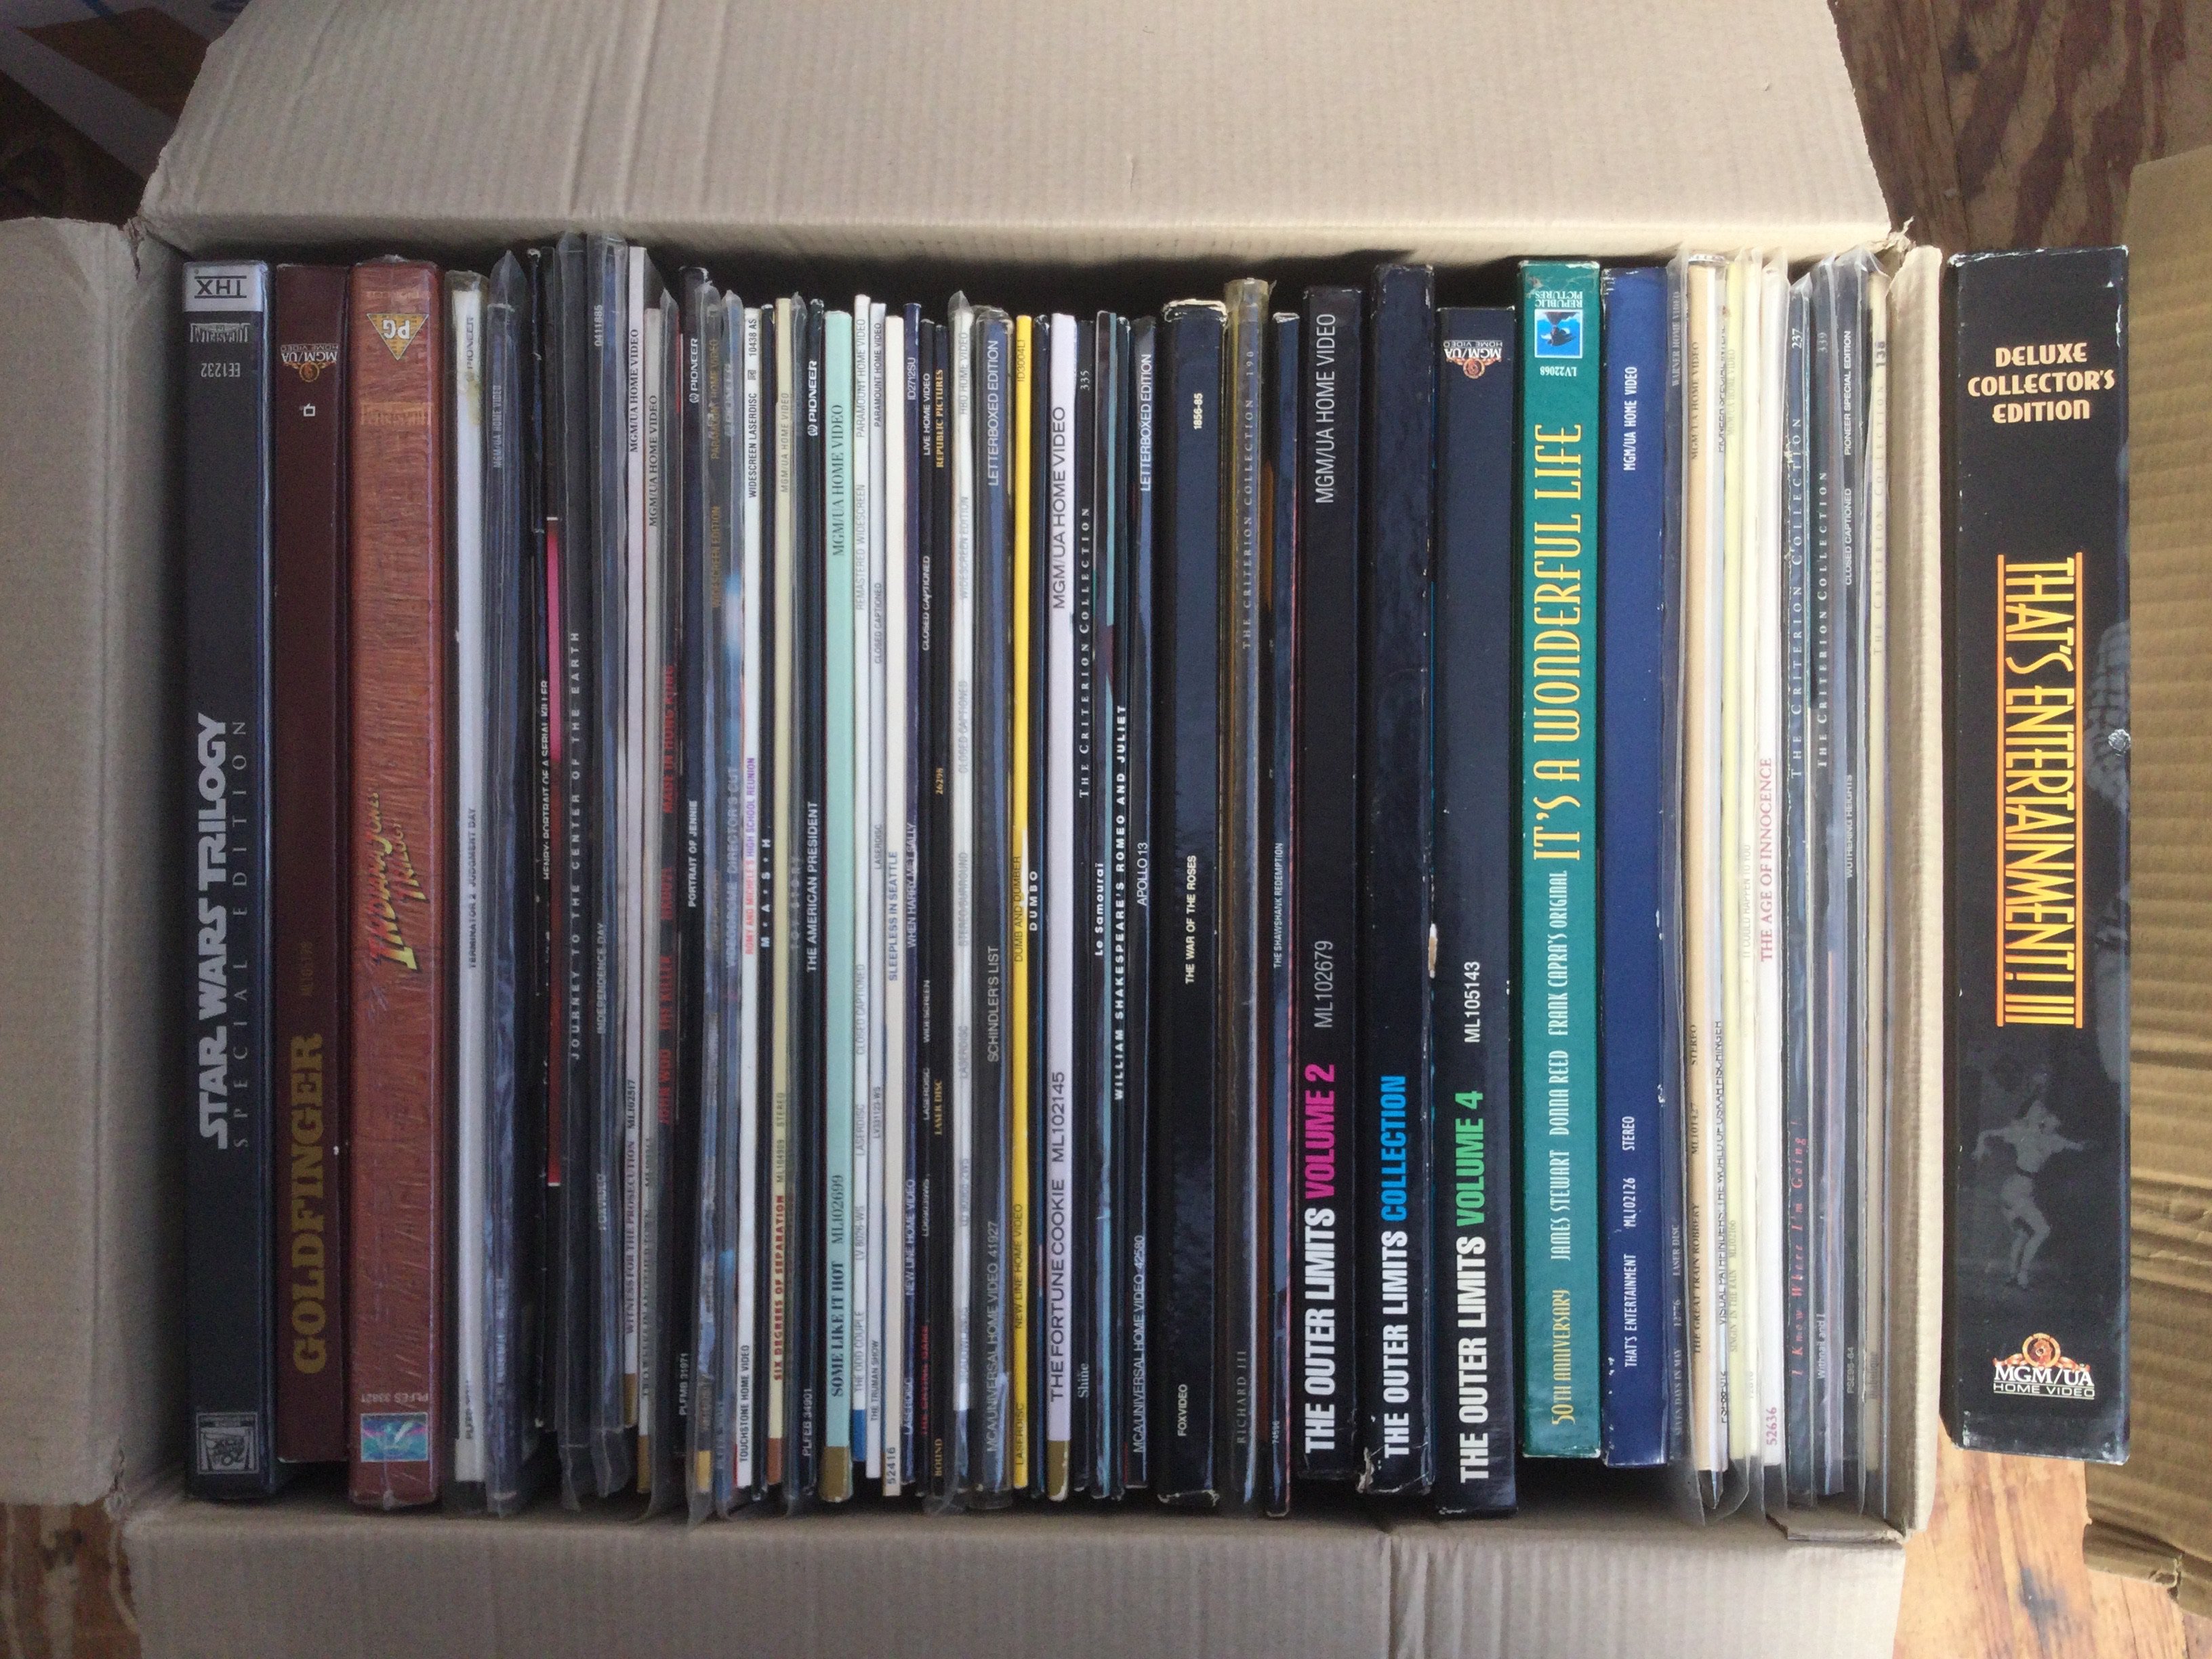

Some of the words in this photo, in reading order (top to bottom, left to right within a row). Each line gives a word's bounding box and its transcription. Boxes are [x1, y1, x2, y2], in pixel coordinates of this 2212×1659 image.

[194, 276, 247, 298] THX
[1535, 291, 1582, 299] PICTURES
[1535, 299, 1582, 308] REPUBLIC
[382, 319, 410, 339] PG
[874, 322, 882, 346] VIDEO
[1315, 313, 1336, 366] VIDEO
[1444, 348, 1502, 358] MGM/UA
[690, 337, 699, 390] PIONEER
[874, 350, 882, 373] HOME
[988, 340, 999, 390] EDITION
[1996, 342, 2087, 367] DELUXE
[808, 361, 817, 422] PIONEER
[874, 375, 882, 427] PARAMOUNT
[1080, 370, 1089, 390] 335
[1315, 371, 1336, 422] HOME
[1623, 365, 1638, 394] VIDEO
[1968, 369, 2115, 396] COLLECTOR'S
[747, 392, 758, 439] LASERDISC
[831, 404, 844, 448] VIDEO
[1193, 392, 1203, 429] 1856-85
[1623, 400, 1638, 426] HOME
[1992, 399, 2090, 424] EDITION
[988, 393, 999, 485] LETTERBOXED
[1052, 406, 1066, 466] VIDEO
[1623, 430, 1638, 470] MGM/UA
[747, 443, 758, 497] WIDESCREEN
[831, 452, 844, 495] HOME
[1315, 428, 1336, 502] MGM/UA
[1533, 423, 1581, 499] LIFE
[1052, 470, 1066, 526] HOME
[831, 497, 844, 556] MGM/UA
[1052, 531, 1066, 609] MGM/UA
[1533, 513, 1581, 742] WONDERFUL
[2005, 557, 2074, 673] THAT'S
[571, 632, 581, 693] EARTH
[571, 709, 581, 742] THE
[1117, 704, 1126, 762] JULIET
[571, 757, 581, 779] OF
[1115, 772, 1126, 804] AND
[1533, 758, 1581, 781] A
[199, 712, 227, 890] TRILOGY
[232, 720, 248, 914] EDITION
[366, 792, 393, 854] JONES
[688, 800, 697, 837] JENNIE
[1760, 758, 1772, 859] INNOCENCE
[571, 793, 581, 869] CENTER
[688, 840, 697, 853] OF
[807, 801, 817, 872] PRESIDENT
[874, 823, 882, 869] LASERDISC
[1115, 814, 1126, 872] ROMEO
[1137, 842, 1148, 855] 13
[1533, 794, 1581, 860] IT'S
[2005, 686, 2074, 983] ENTERTAINMENT!
[393, 821, 426, 901] TRILOGY
[688, 857, 697, 906] PORTRAIT
[888, 851, 898, 899] SEATTLE
[1137, 857, 1148, 905] APOLLO
[1185, 855, 1196, 890] ROSES
[1273, 842, 1283, 895] REDEMPTION
[1760, 863, 1772, 885] OF
[367, 851, 417, 971] INDIANA
[571, 884, 581, 918] THE
[807, 876, 817, 943] AMERICAN
[888, 903, 898, 913] IN
[1029, 870, 1038, 930] DUMBO
[1094, 862, 1104, 933] Samouraï
[1185, 893, 1196, 913] THE
[1549, 869, 1568, 927] ORIGINAL
[1760, 890, 1772, 923] AGE
[571, 933, 581, 954] TO
[1185, 917, 1196, 932] OF
[1185, 935, 1196, 959] WAR
[1273, 897, 1283, 950] SHAWSHANK
[1760, 928, 1772, 961] THE
[199, 898, 227, 1019] WARS
[807, 947, 817, 972] THE
[888, 917, 898, 980] SLEEPLESS
[987, 946, 1000, 972] LIST
[1094, 940, 1104, 956] Le
[1115, 881, 1126, 1019] SHAKESPEARE'S
[1273, 952, 1283, 968] THE
[1547, 933, 1568, 986] CAPRA'S
[1185, 964, 1196, 983] THE
[1313, 940, 1334, 1027] ML102679
[571, 970, 581, 1059] JOURNEY
[987, 976, 1000, 1061] SCHINDLER'S
[1465, 961, 1481, 1042] ML105143
[1548, 991, 1568, 1035] FRANK
[2005, 996, 2074, 1025] III
[232, 960, 248, 1147] SPECIAL
[1115, 1029, 1124, 1099] WILLIAM
[1305, 1063, 1335, 1082] 2
[1549, 1050, 1569, 1083] REED
[199, 1026, 227, 1148] STAR
[1456, 1090, 1488, 1109] 4
[1549, 1088, 1570, 1134] DONNA
[1050, 1071, 1065, 1162] ML102145
[1622, 1115, 1635, 1150] STEREO
[1305, 1089, 1335, 1199] VOLUME
[1381, 1076, 1410, 1221] COLLECTION
[1456, 1118, 1488, 1225] VOLUME
[1549, 1149, 1570, 1210] STEWART
[291, 1033, 326, 1373] GOLDFINGER
[831, 1174, 844, 1244] ML102699
[1050, 1179, 1065, 1254] COOKIE
[1623, 1176, 1638, 1227] ML102126
[774, 1195, 785, 1274] SEPARATION
[987, 1221, 999, 1256] 41927
[1305, 1208, 1335, 1299] LIMITS
[1549, 1216, 1571, 1261] JAMES
[774, 1278, 785, 1294] OF
[831, 1261, 844, 1290] HOT
[987, 1262, 999, 1302] VIDEO
[1381, 1230, 1410, 1314] LIMITS
[1456, 1236, 1488, 1328] LIMITS
[1623, 1253, 1638, 1330] ENTERTAINMENT
[831, 1294, 844, 1309] IT
[987, 1305, 999, 1343] HOME
[1050, 1259, 1065, 1356] FORTUNE
[774, 1299, 785, 1355] DEGREES
[831, 1313, 844, 1349] LIKE
[1552, 1288, 1572, 1380] ANNIVERSARY
[1623, 1336, 1638, 1366] THAT'S
[740, 1345, 750, 1370] VIDEO
[774, 1359, 785, 1380] SIX
[831, 1352, 844, 1397] SOME
[870, 1340, 880, 1364] SHOW
[1305, 1308, 1335, 1395] OUTER
[1381, 1324, 1410, 1402] OUTER
[740, 1375, 750, 1400] HOME
[870, 1367, 880, 1400] TRUMAN
[987, 1347, 999, 1451] MCA/UNIVERSAL
[1050, 1361, 1065, 1401] THE
[1077, 1362, 1089, 1397] Shine
[1456, 1337, 1488, 1422] OUTER
[1993, 1383, 2040, 1395] HOME
[2047, 1386, 2095, 1397] VIDEO
[1994, 1365, 2094, 1387] MGM/UA
[870, 1404, 880, 1420] THE
[1178, 1384, 1187, 1435] FOXVIDEO
[1305, 1404, 1335, 1452] THE
[1549, 1385, 1576, 1424] 50TH
[1766, 1406, 1778, 1445] 52636
[740, 1404, 750, 1462] TOUCHSTONE
[1381, 1412, 1410, 1458] THE
[886, 1446, 896, 1484] 52416
[1456, 1433, 1488, 1482] THE
